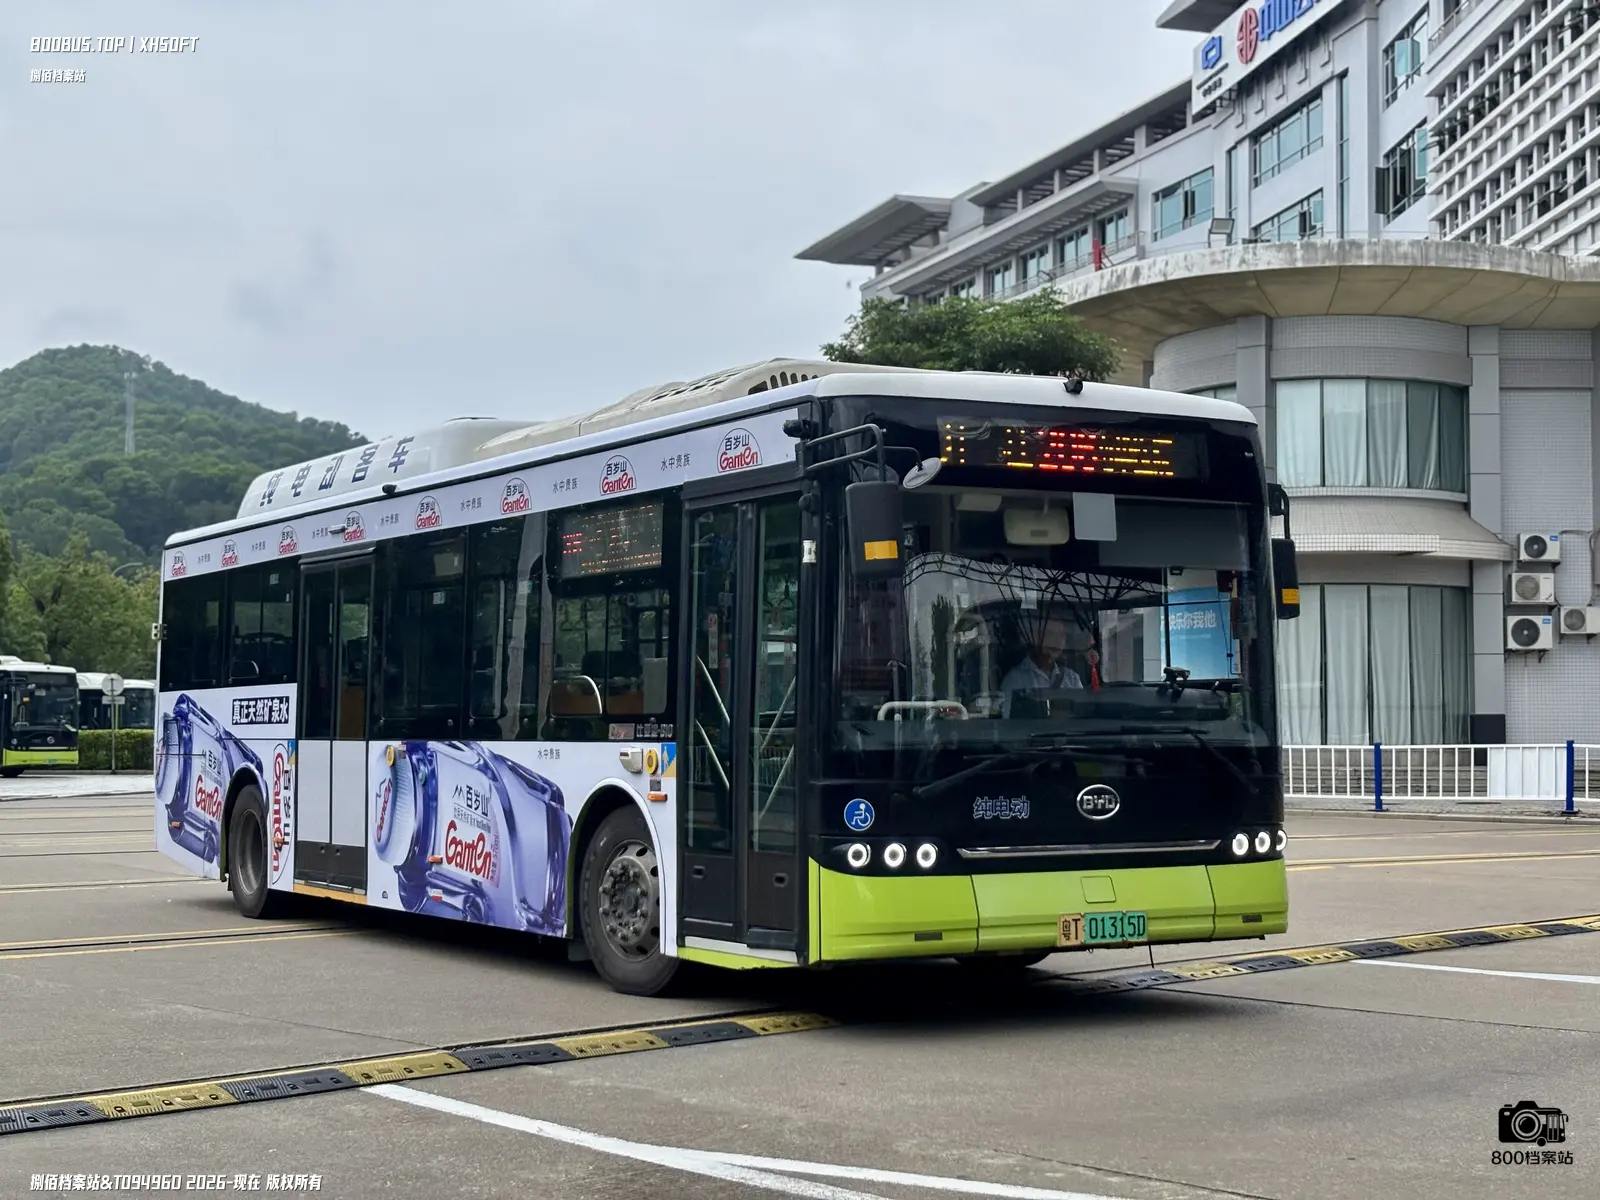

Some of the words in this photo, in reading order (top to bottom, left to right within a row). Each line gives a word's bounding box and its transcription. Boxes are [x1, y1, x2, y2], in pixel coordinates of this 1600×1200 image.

[725, 434, 750, 451] 百岁山
[606, 461, 627, 476] 百岁山
[661, 453, 691, 471] 水中贵族
[260, 436, 415, 507] 纯电动客车
[506, 483, 524, 497] 百岁山
[552, 478, 578, 494] 水中贵族
[419, 500, 435, 514] 百岁山
[460, 498, 482, 512] 水中贵族
[233, 697, 289, 724] 真正天然矿泉水
[465, 784, 489, 817] 百岁山
[973, 795, 1030, 819] 纯电动
[1082, 794, 1116, 810] BYD
[445, 819, 492, 880] Ganten
[1089, 914, 1146, 940] 01315D
